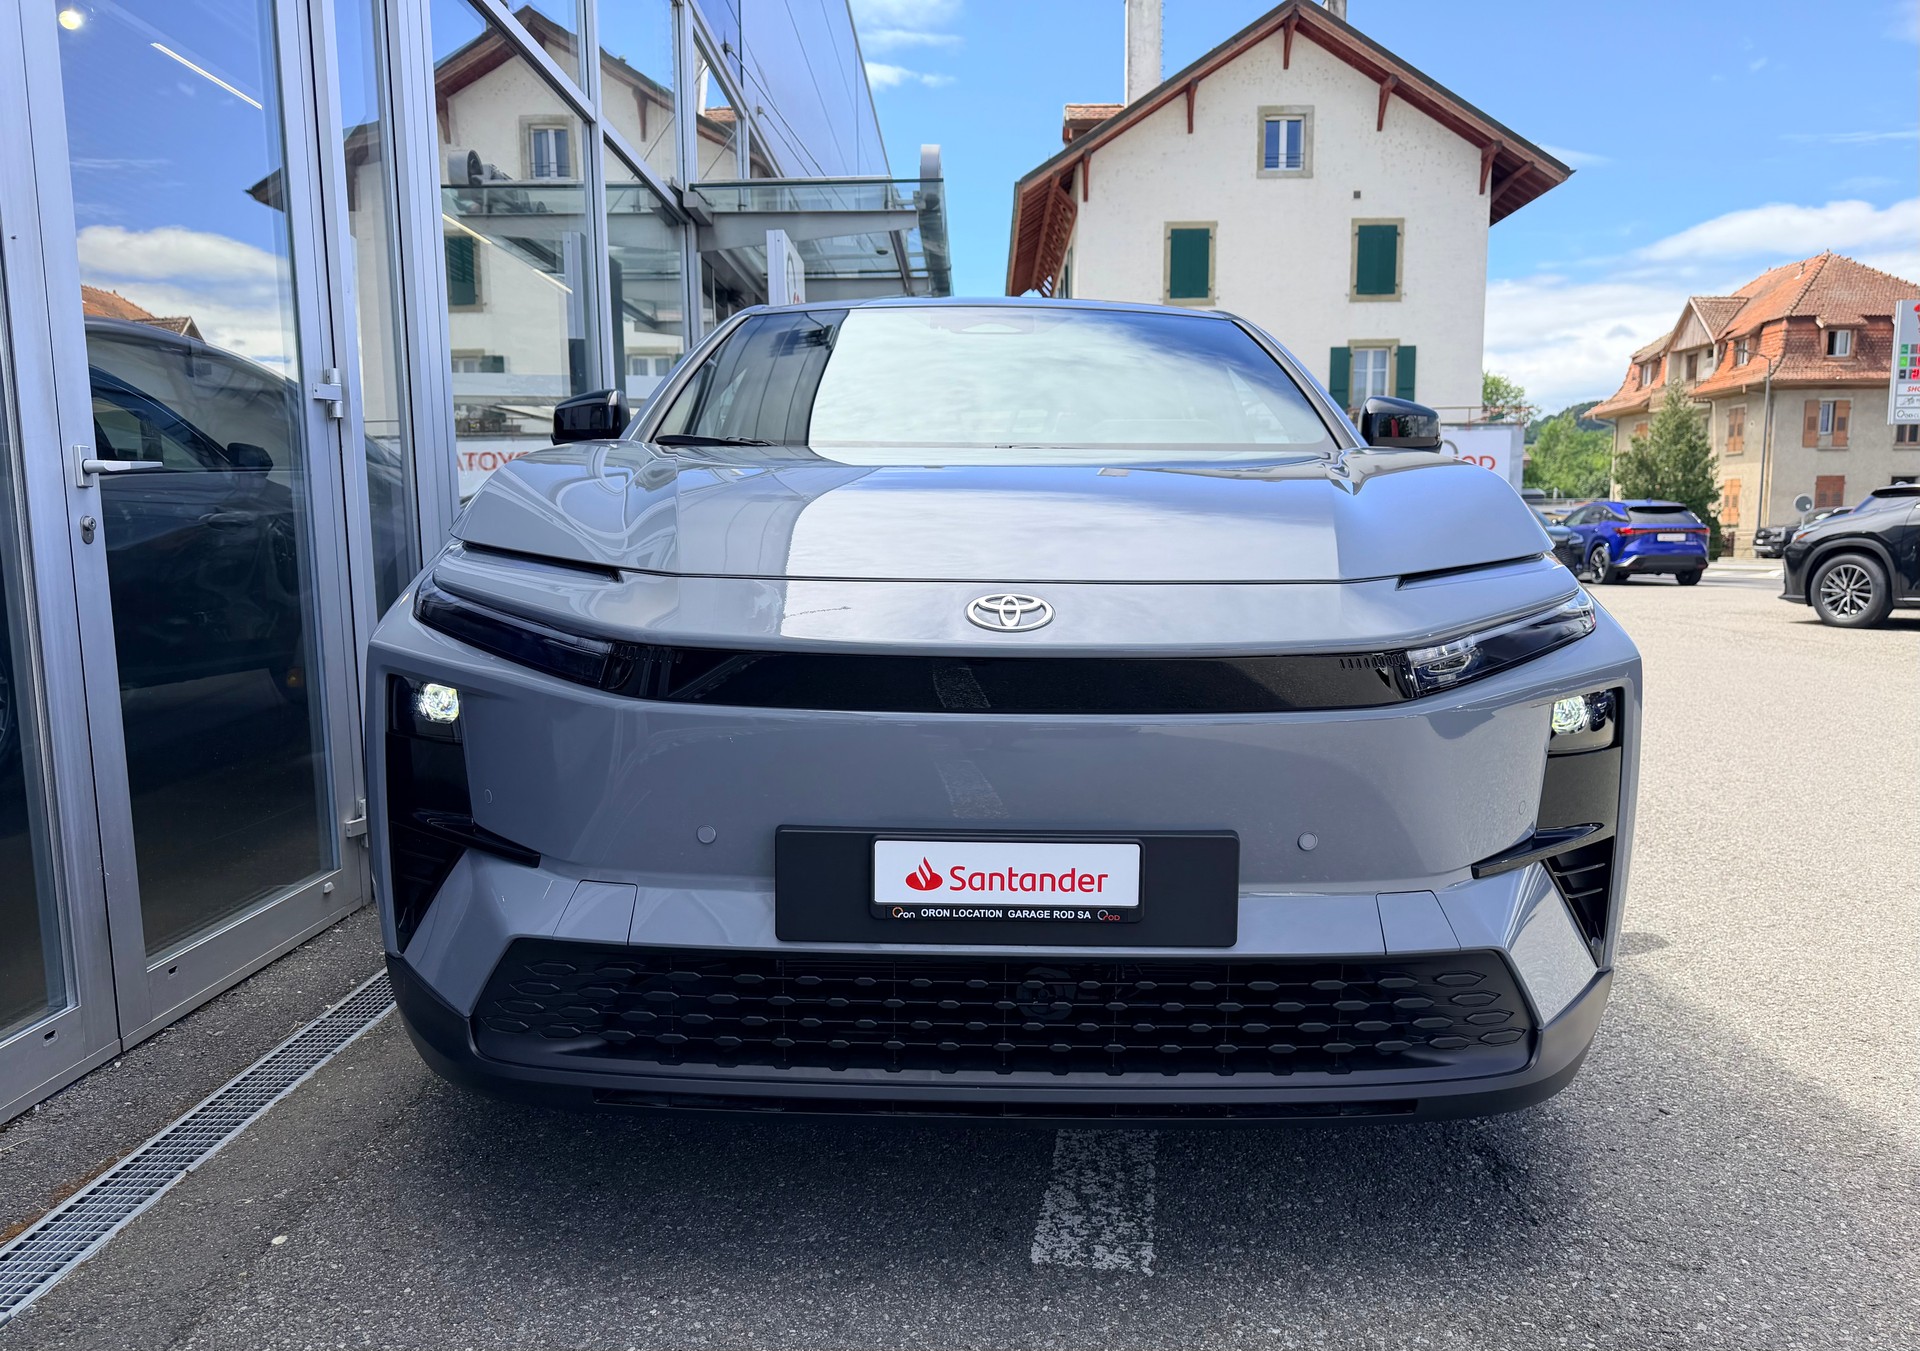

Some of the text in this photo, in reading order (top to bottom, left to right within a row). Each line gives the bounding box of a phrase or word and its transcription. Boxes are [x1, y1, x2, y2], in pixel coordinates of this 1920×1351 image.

[949, 866, 1109, 893] Santander
[920, 908, 1091, 919] ORON LOCATION GARAGE ROD SA
